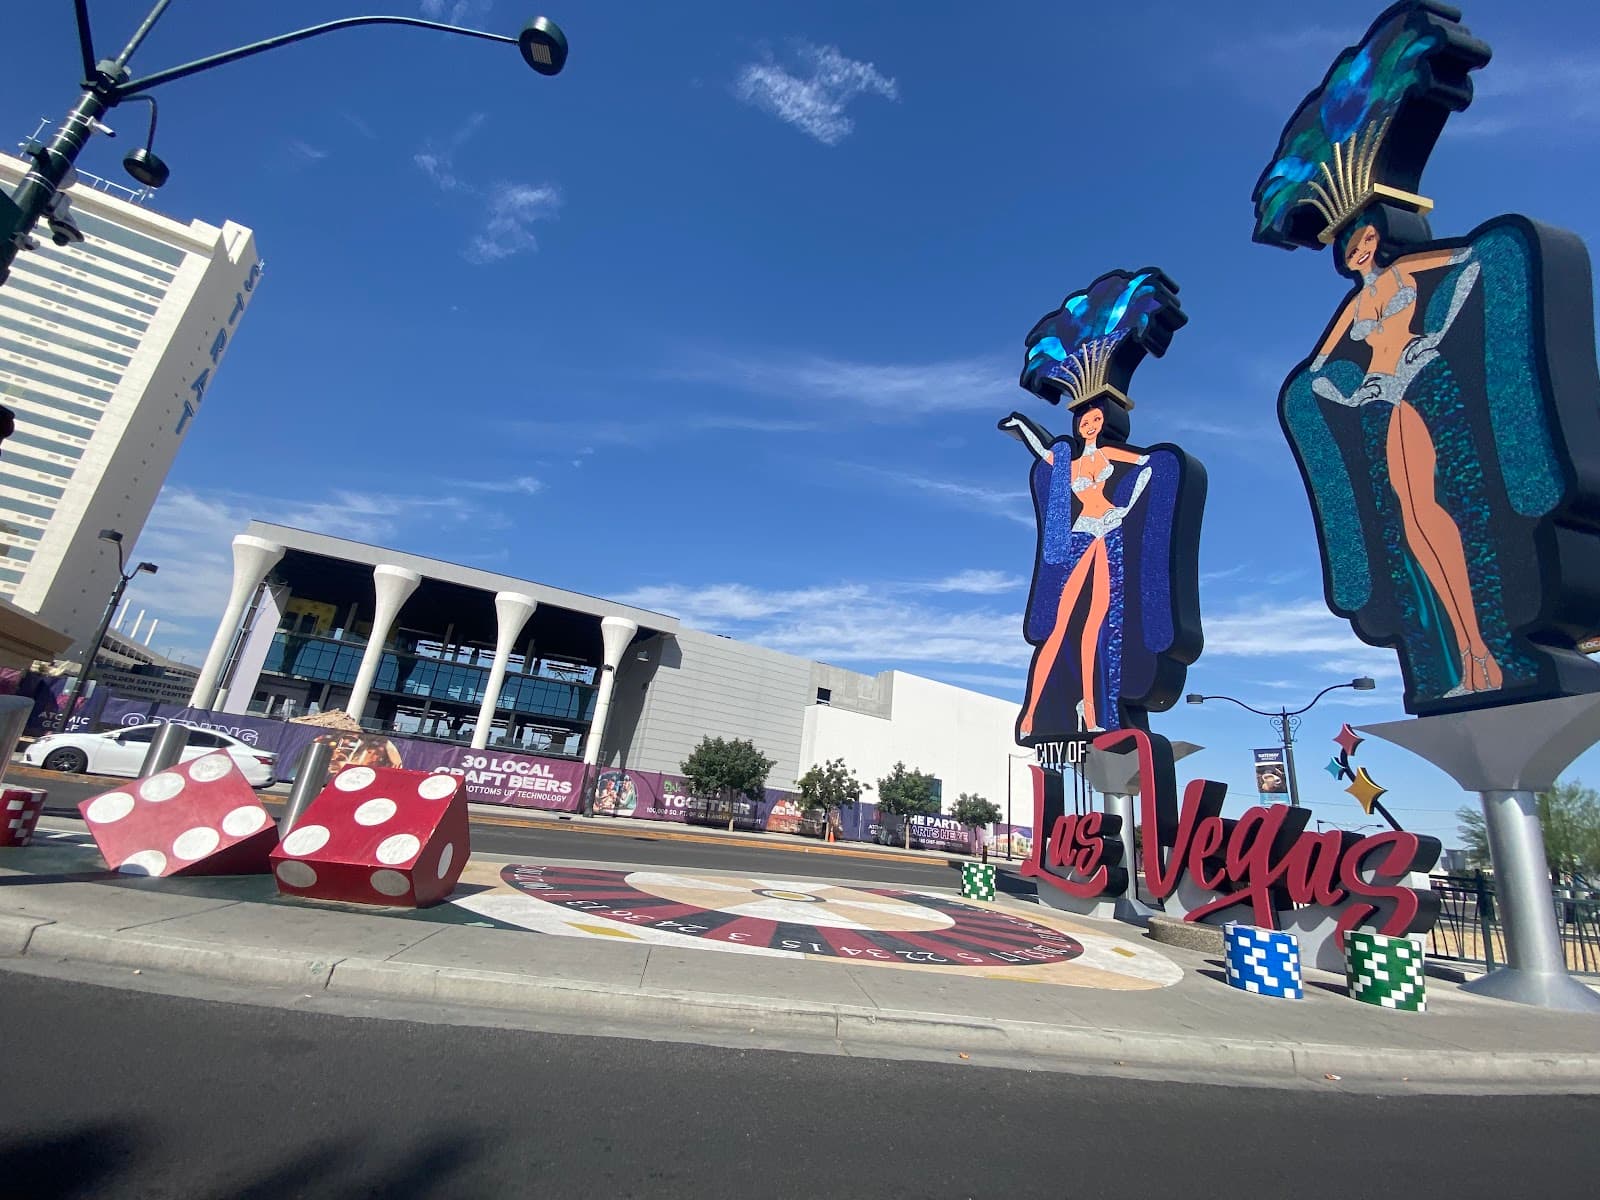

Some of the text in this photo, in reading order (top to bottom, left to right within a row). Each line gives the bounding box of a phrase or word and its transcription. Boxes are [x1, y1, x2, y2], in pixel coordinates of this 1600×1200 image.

[136, 678, 194, 692] ENTERTAINME
[1035, 741, 1087, 763] CITY OF
[461, 755, 554, 778] 30 LOCAL
[508, 776, 572, 794] BEERS
[504, 789, 515, 797] UP
[517, 790, 567, 803] TECHNOLOGY
[663, 794, 750, 814] TOGETHER
[927, 817, 964, 831] PARTY
[1021, 765, 1107, 897] Las
[940, 829, 969, 842] HERE
[1092, 728, 1419, 953] Vegas
[728, 932, 752, 942] 3
[781, 940, 824, 952] 15
[840, 946, 890, 959] 34
